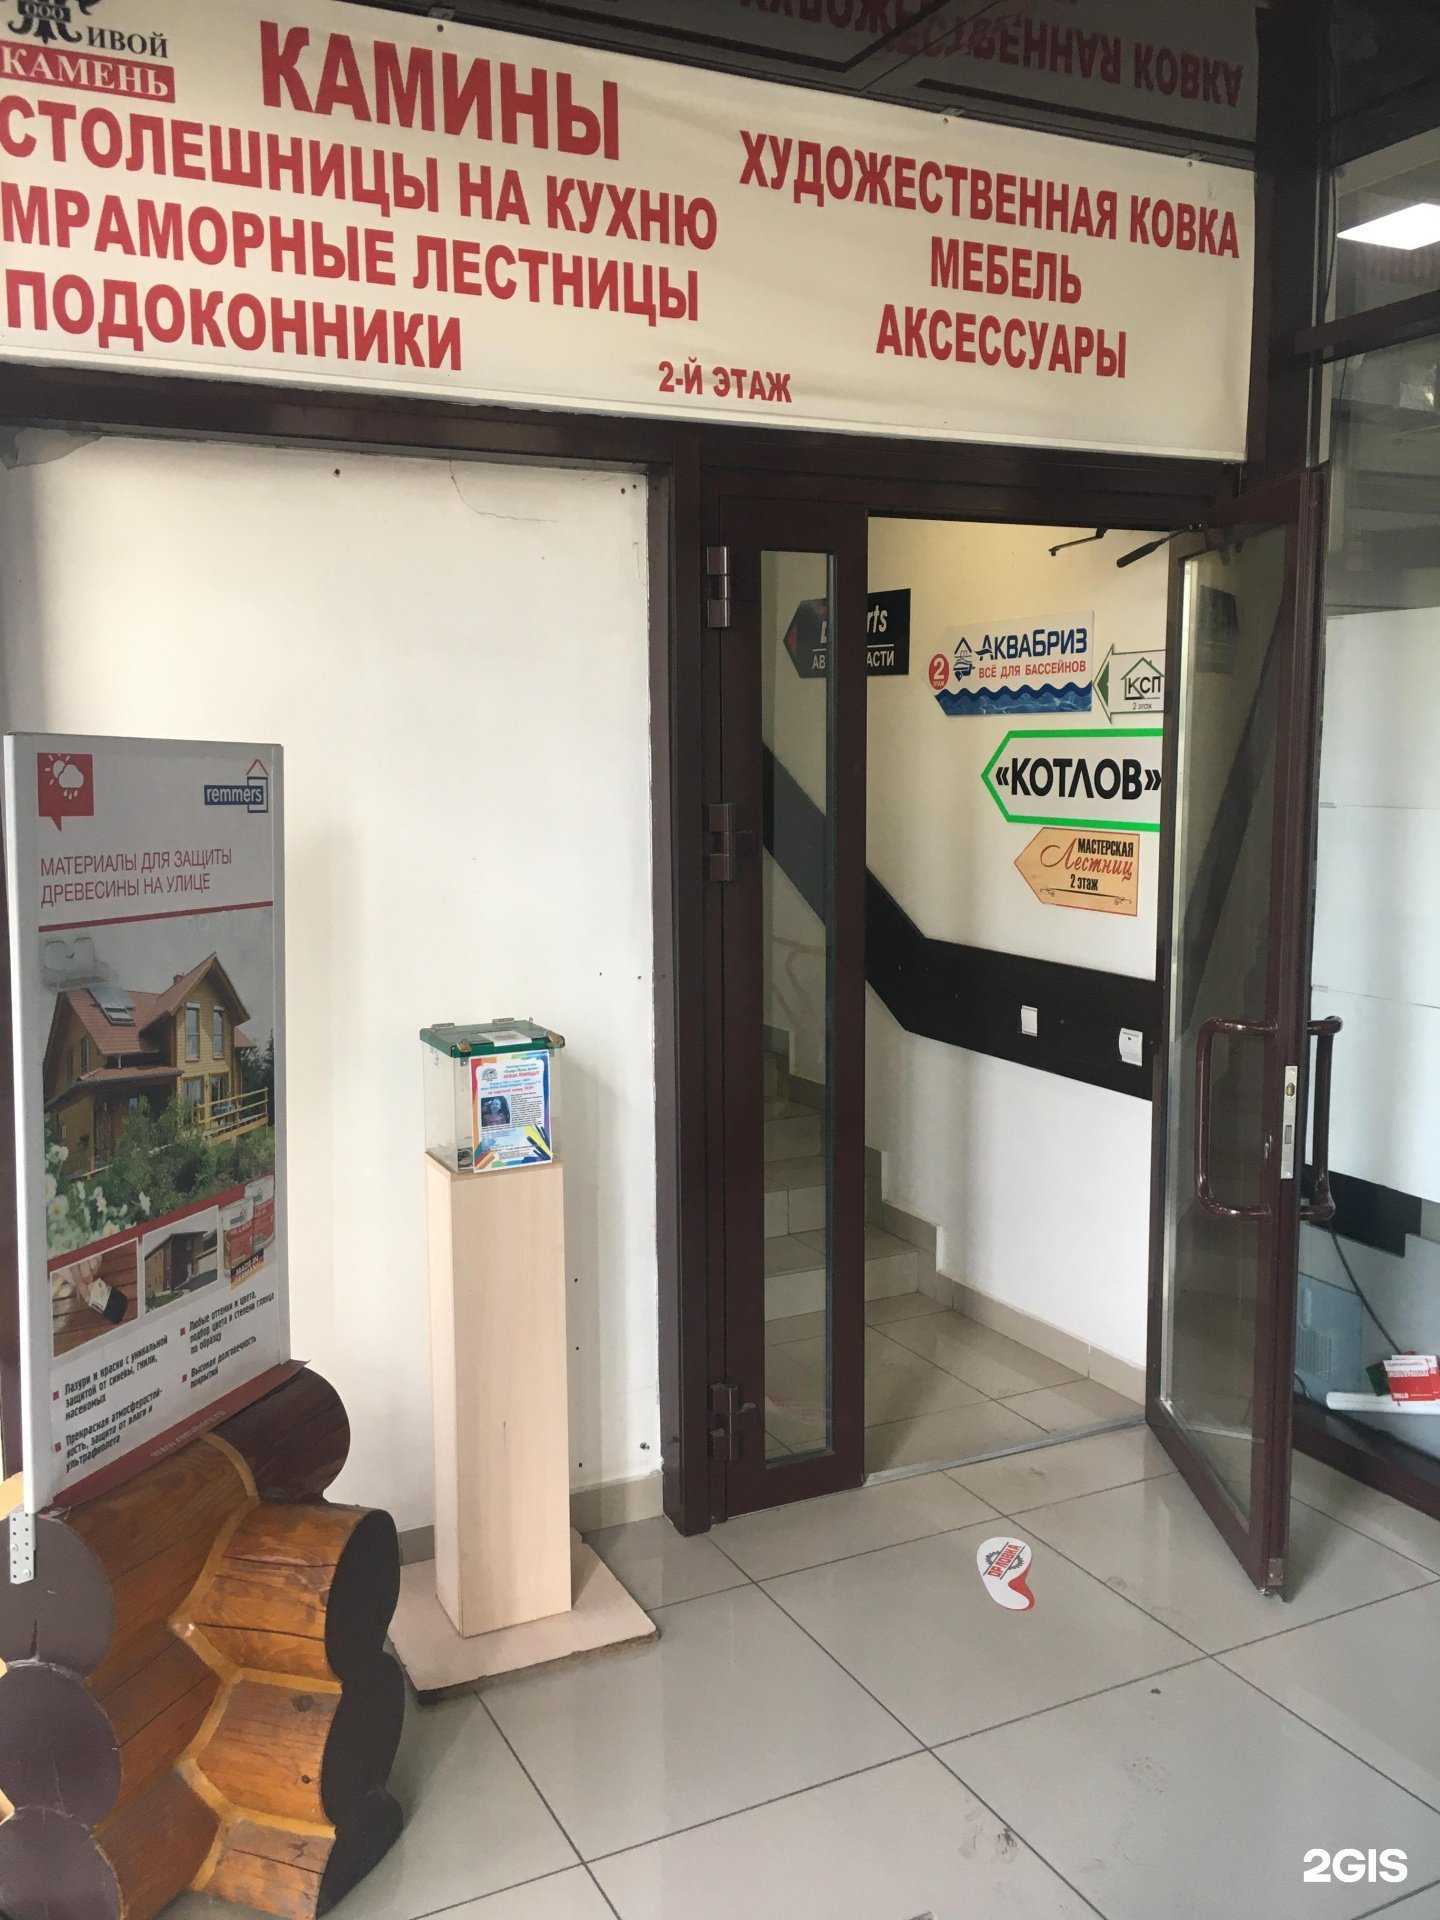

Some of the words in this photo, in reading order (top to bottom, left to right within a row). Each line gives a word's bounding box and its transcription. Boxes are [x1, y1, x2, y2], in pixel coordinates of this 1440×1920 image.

[1, 46, 169, 97] КАМЕНЬ
[260, 21, 620, 160] КАМИНЫ
[0, 95, 440, 218] СТОЛЕШНИЦЫ
[458, 162, 530, 225] НА
[546, 175, 718, 252] КУХНЮ
[739, 129, 1117, 240] ХУДОЖЕСТВЕННАЯ
[1130, 195, 1240, 259] КОВКА
[2, 181, 397, 287] МРАМОРНЫЕ
[412, 234, 699, 327] ЛЕСТНИЦЫ
[930, 235, 1082, 304] МЕБЕЛЬ
[5, 268, 462, 371] ПОДОКОННИКИ
[876, 304, 1127, 379] АКСЕССУАРЫ
[658, 356, 703, 395] 2-Й
[712, 366, 792, 403] ЭТАЖ
[933, 657, 945, 680] 2
[979, 664, 997, 679] ВСЁ
[1000, 663, 1021, 679] ДЛЯ
[1025, 660, 1087, 676] БАССЕЙНОВ
[1127, 675, 1161, 699] КСП
[206, 786, 263, 803] remmers
[40, 853, 137, 876] МАТЕРИАЛЫ
[141, 852, 170, 873] ДЛЯ
[174, 848, 232, 869] ЗАЩИТЫ
[1040, 838, 1133, 881] Лестниц
[1078, 838, 1134, 858] МАСТЕРСКАЯ
[40, 878, 139, 909] ДРЕВЕСИНЫ
[144, 876, 163, 894] НА
[167, 873, 210, 893] УЛИЦЕ
[1070, 874, 1076, 888] 2
